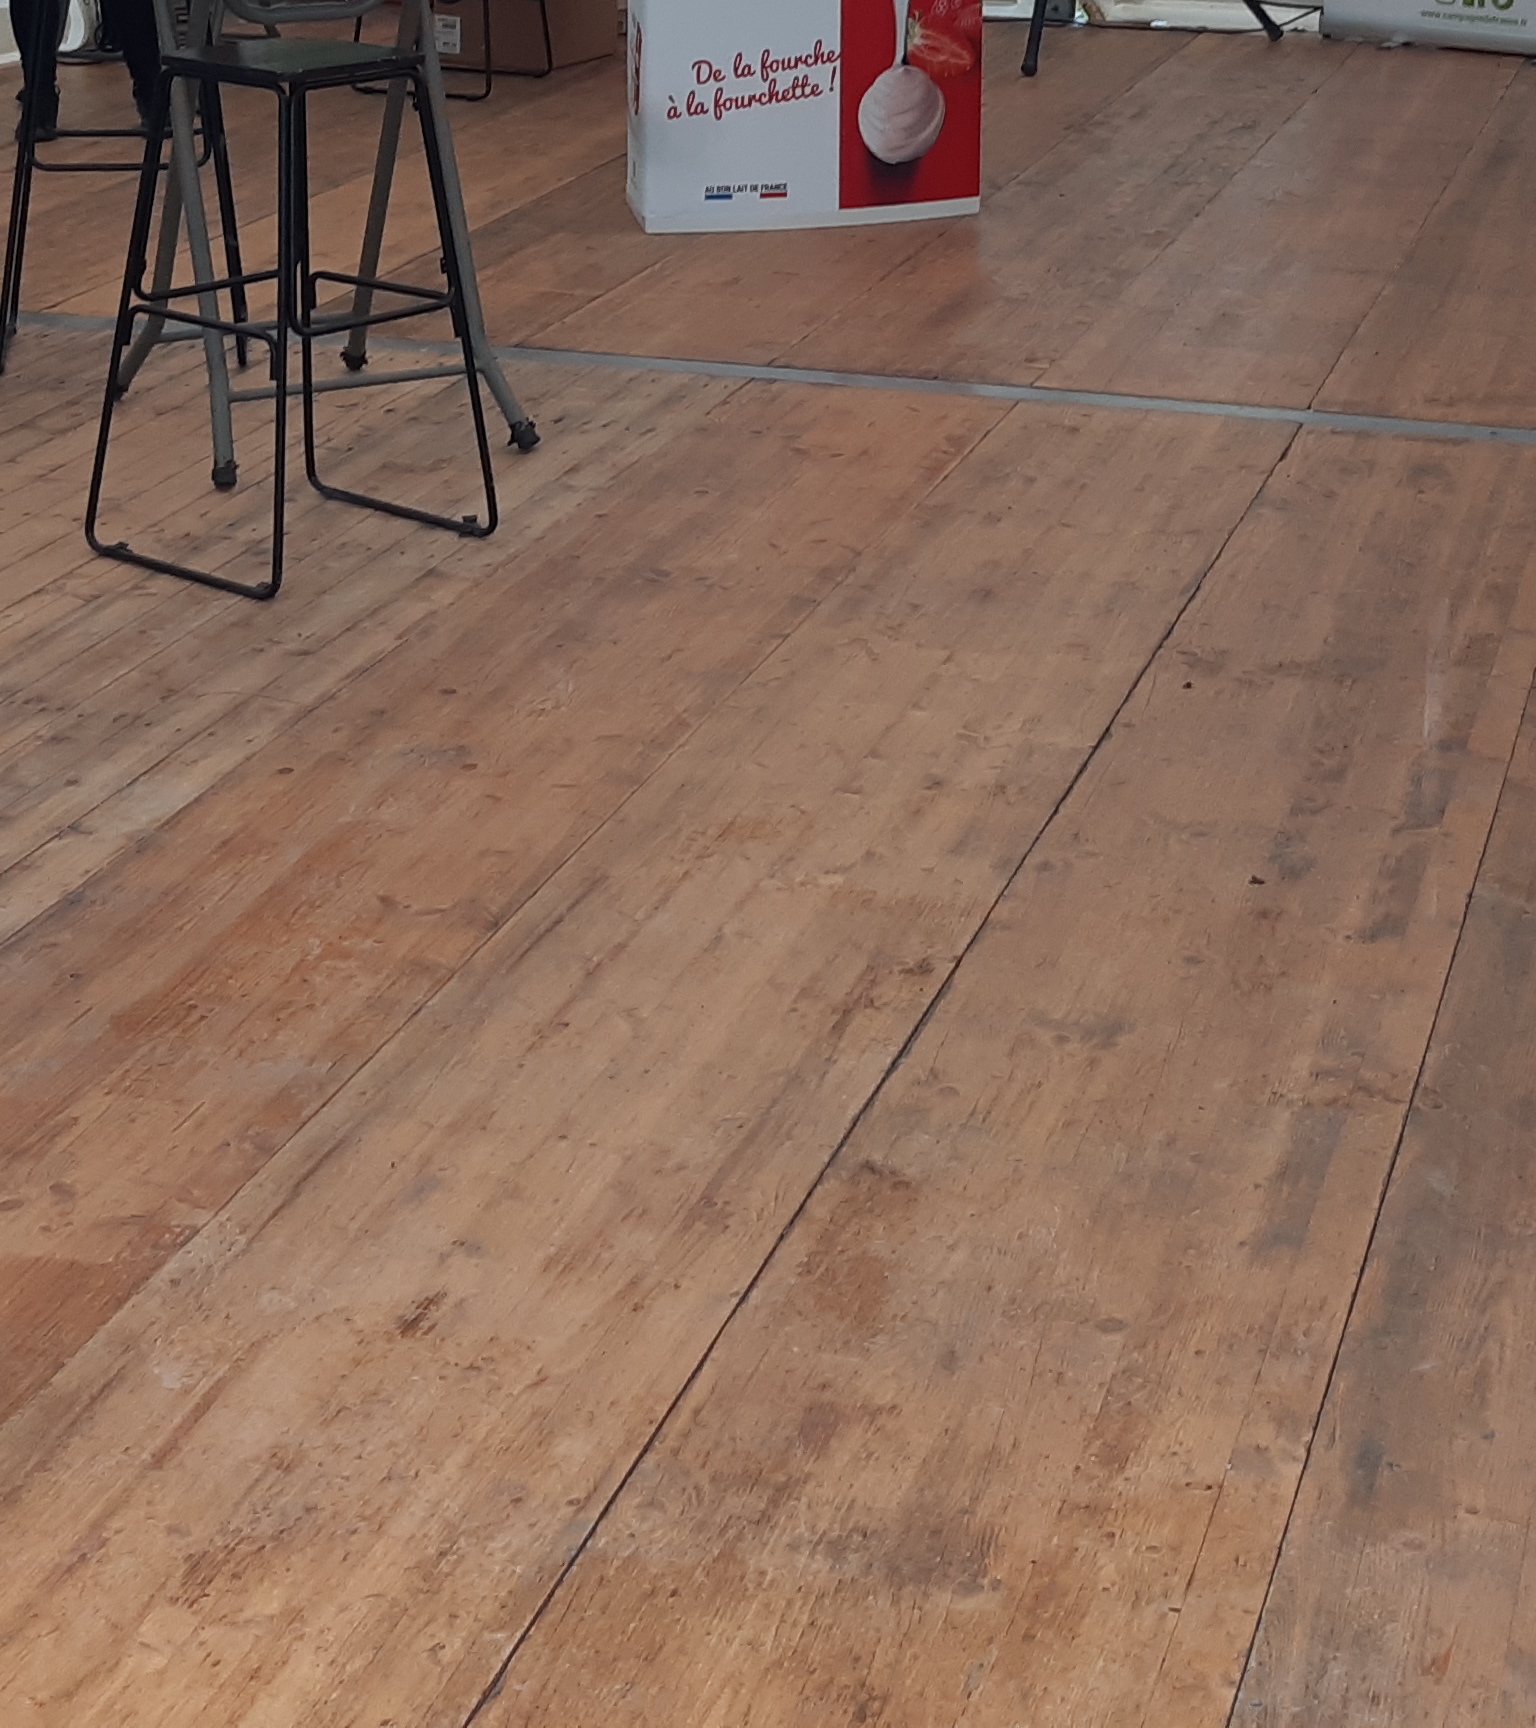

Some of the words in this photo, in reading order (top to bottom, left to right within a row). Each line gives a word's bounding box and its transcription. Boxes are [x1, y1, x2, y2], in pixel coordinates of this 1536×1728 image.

[692, 59, 726, 85] De
[733, 52, 756, 79] la
[760, 39, 841, 83] fourche
[667, 95, 681, 120] à
[686, 90, 709, 116] la
[714, 74, 823, 121] fourchette
[828, 66, 837, 92] !
[733, 184, 748, 193] LAIT
